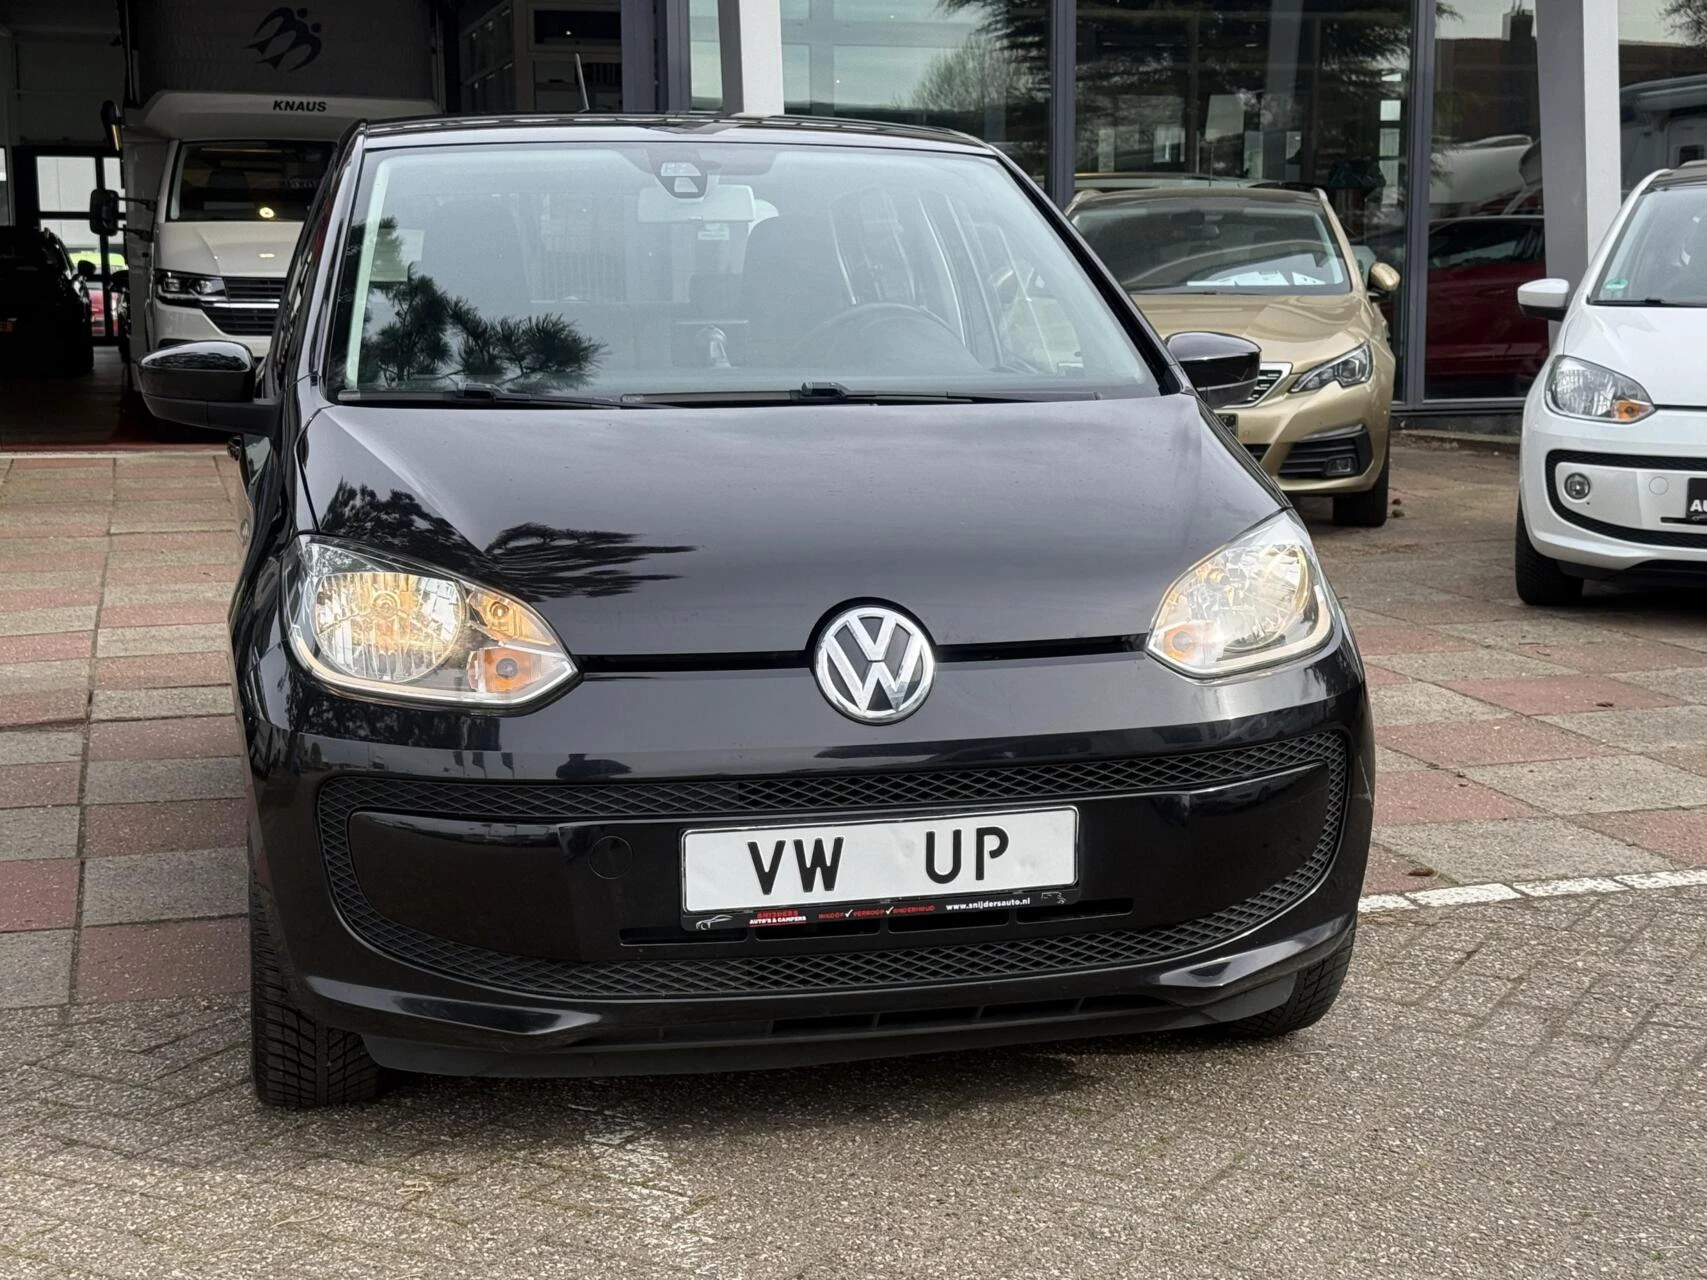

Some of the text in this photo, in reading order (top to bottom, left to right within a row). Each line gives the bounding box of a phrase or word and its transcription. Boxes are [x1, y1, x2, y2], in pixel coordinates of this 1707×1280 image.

[273, 99, 328, 113] KNAUS
[746, 826, 1009, 896] VW UP
[945, 897, 1031, 911] www.snijdersauto.nl
[749, 917, 772, 925] AUTO'S
[777, 915, 807, 923] CAMPERS
